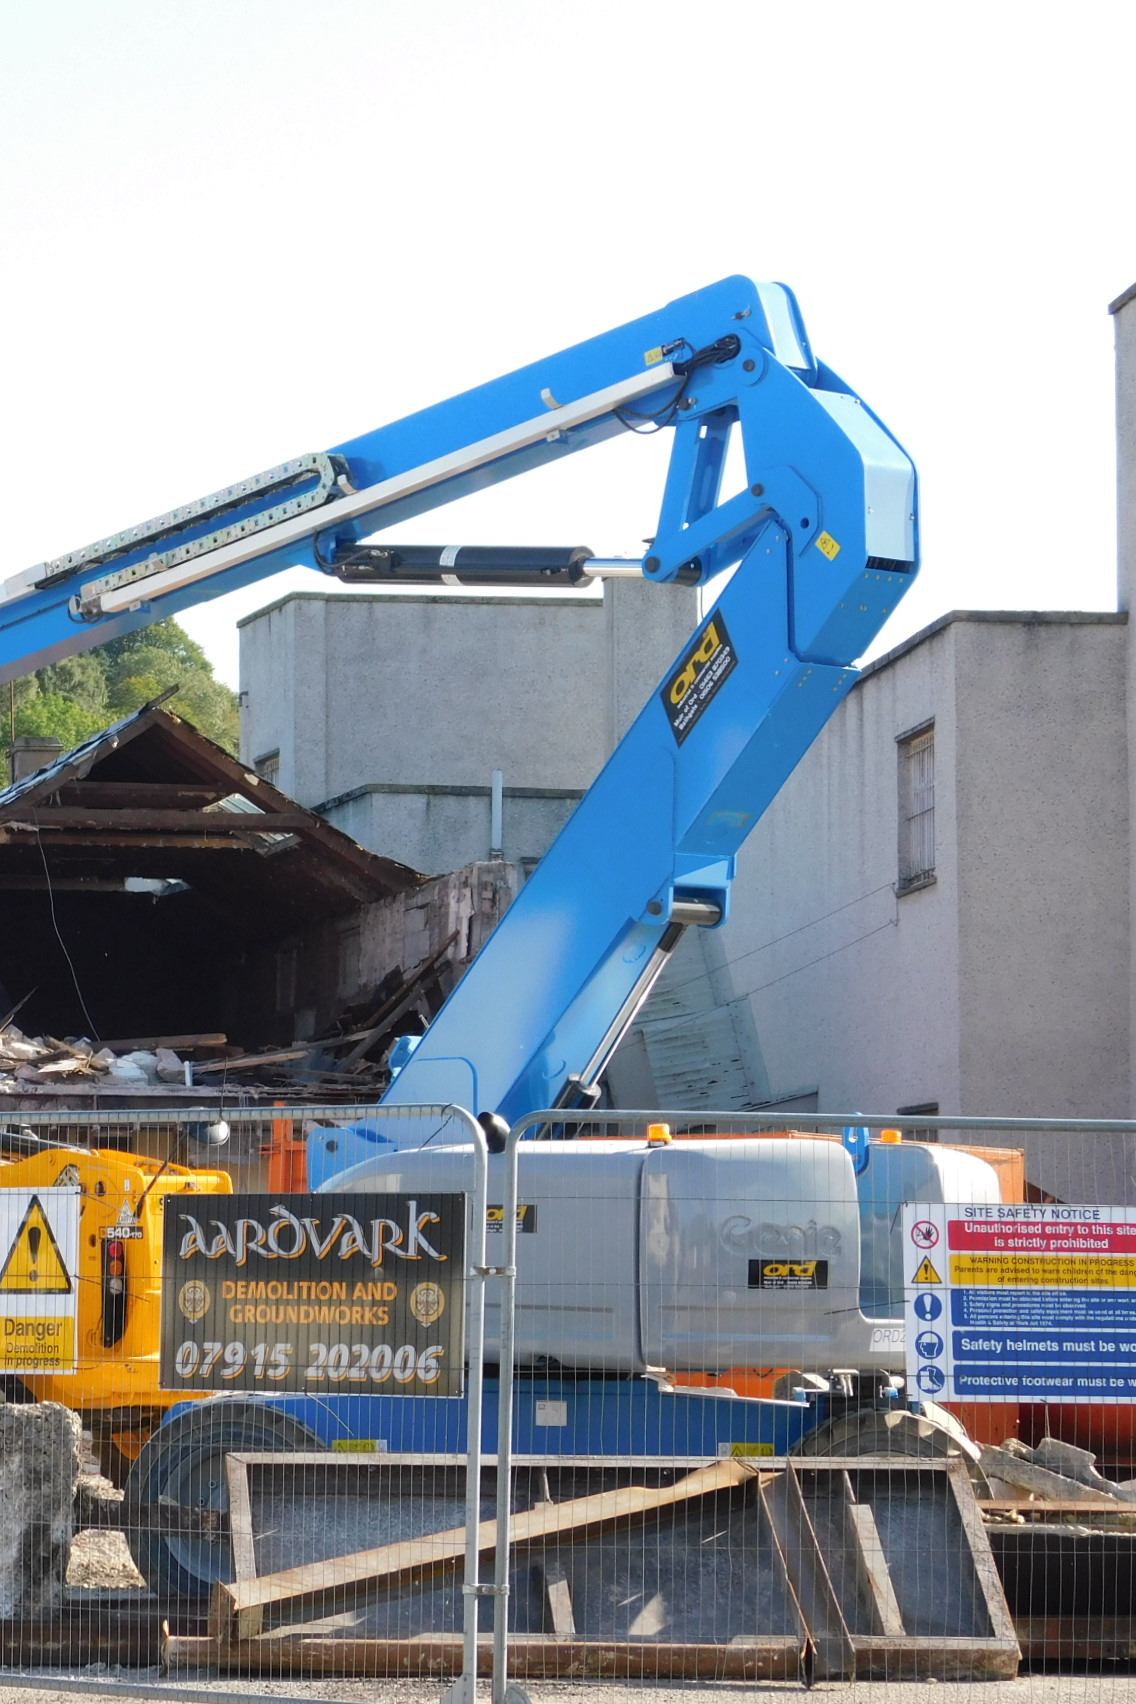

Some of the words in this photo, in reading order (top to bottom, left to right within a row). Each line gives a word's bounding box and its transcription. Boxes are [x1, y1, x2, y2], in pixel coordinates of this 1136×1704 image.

[670, 621, 720, 704] ord
[965, 1207, 993, 1218] SITE
[998, 1208, 1046, 1219] SAFETY
[1052, 1209, 1100, 1220] NOTICE
[964, 1222, 1042, 1234] Unauthorised
[1045, 1224, 1074, 1236] entry
[1077, 1224, 1089, 1235] to
[1092, 1224, 1114, 1235] this
[1117, 1225, 1136, 1235] site
[994, 1237, 1005, 1248] is
[1008, 1238, 1046, 1250] strictly
[1050, 1238, 1109, 1250] prohibited
[763, 1261, 817, 1276] ord
[970, 1257, 1009, 1265] WARNING
[1011, 1257, 1076, 1266] CONSTRUCTION
[1000, 1266, 1030, 1274] advised
[222, 1281, 347, 1300] DEMOLITION
[352, 1282, 398, 1301] AND
[229, 1305, 389, 1326] GROUNDWORKS
[4, 1319, 62, 1341] Danger
[6, 1342, 59, 1353] Demolition
[961, 1338, 1002, 1353] Safety
[1007, 1339, 1059, 1351] helmets
[1063, 1340, 1095, 1352] must
[1099, 1340, 1116, 1352] be
[14, 1357, 61, 1368] progress
[176, 1340, 292, 1381] 07915
[304, 1343, 444, 1384] 202006
[959, 1375, 1019, 1386] Protective
[1022, 1375, 1073, 1386] footwear
[1077, 1377, 1107, 1387] must
[1110, 1377, 1124, 1387] be
